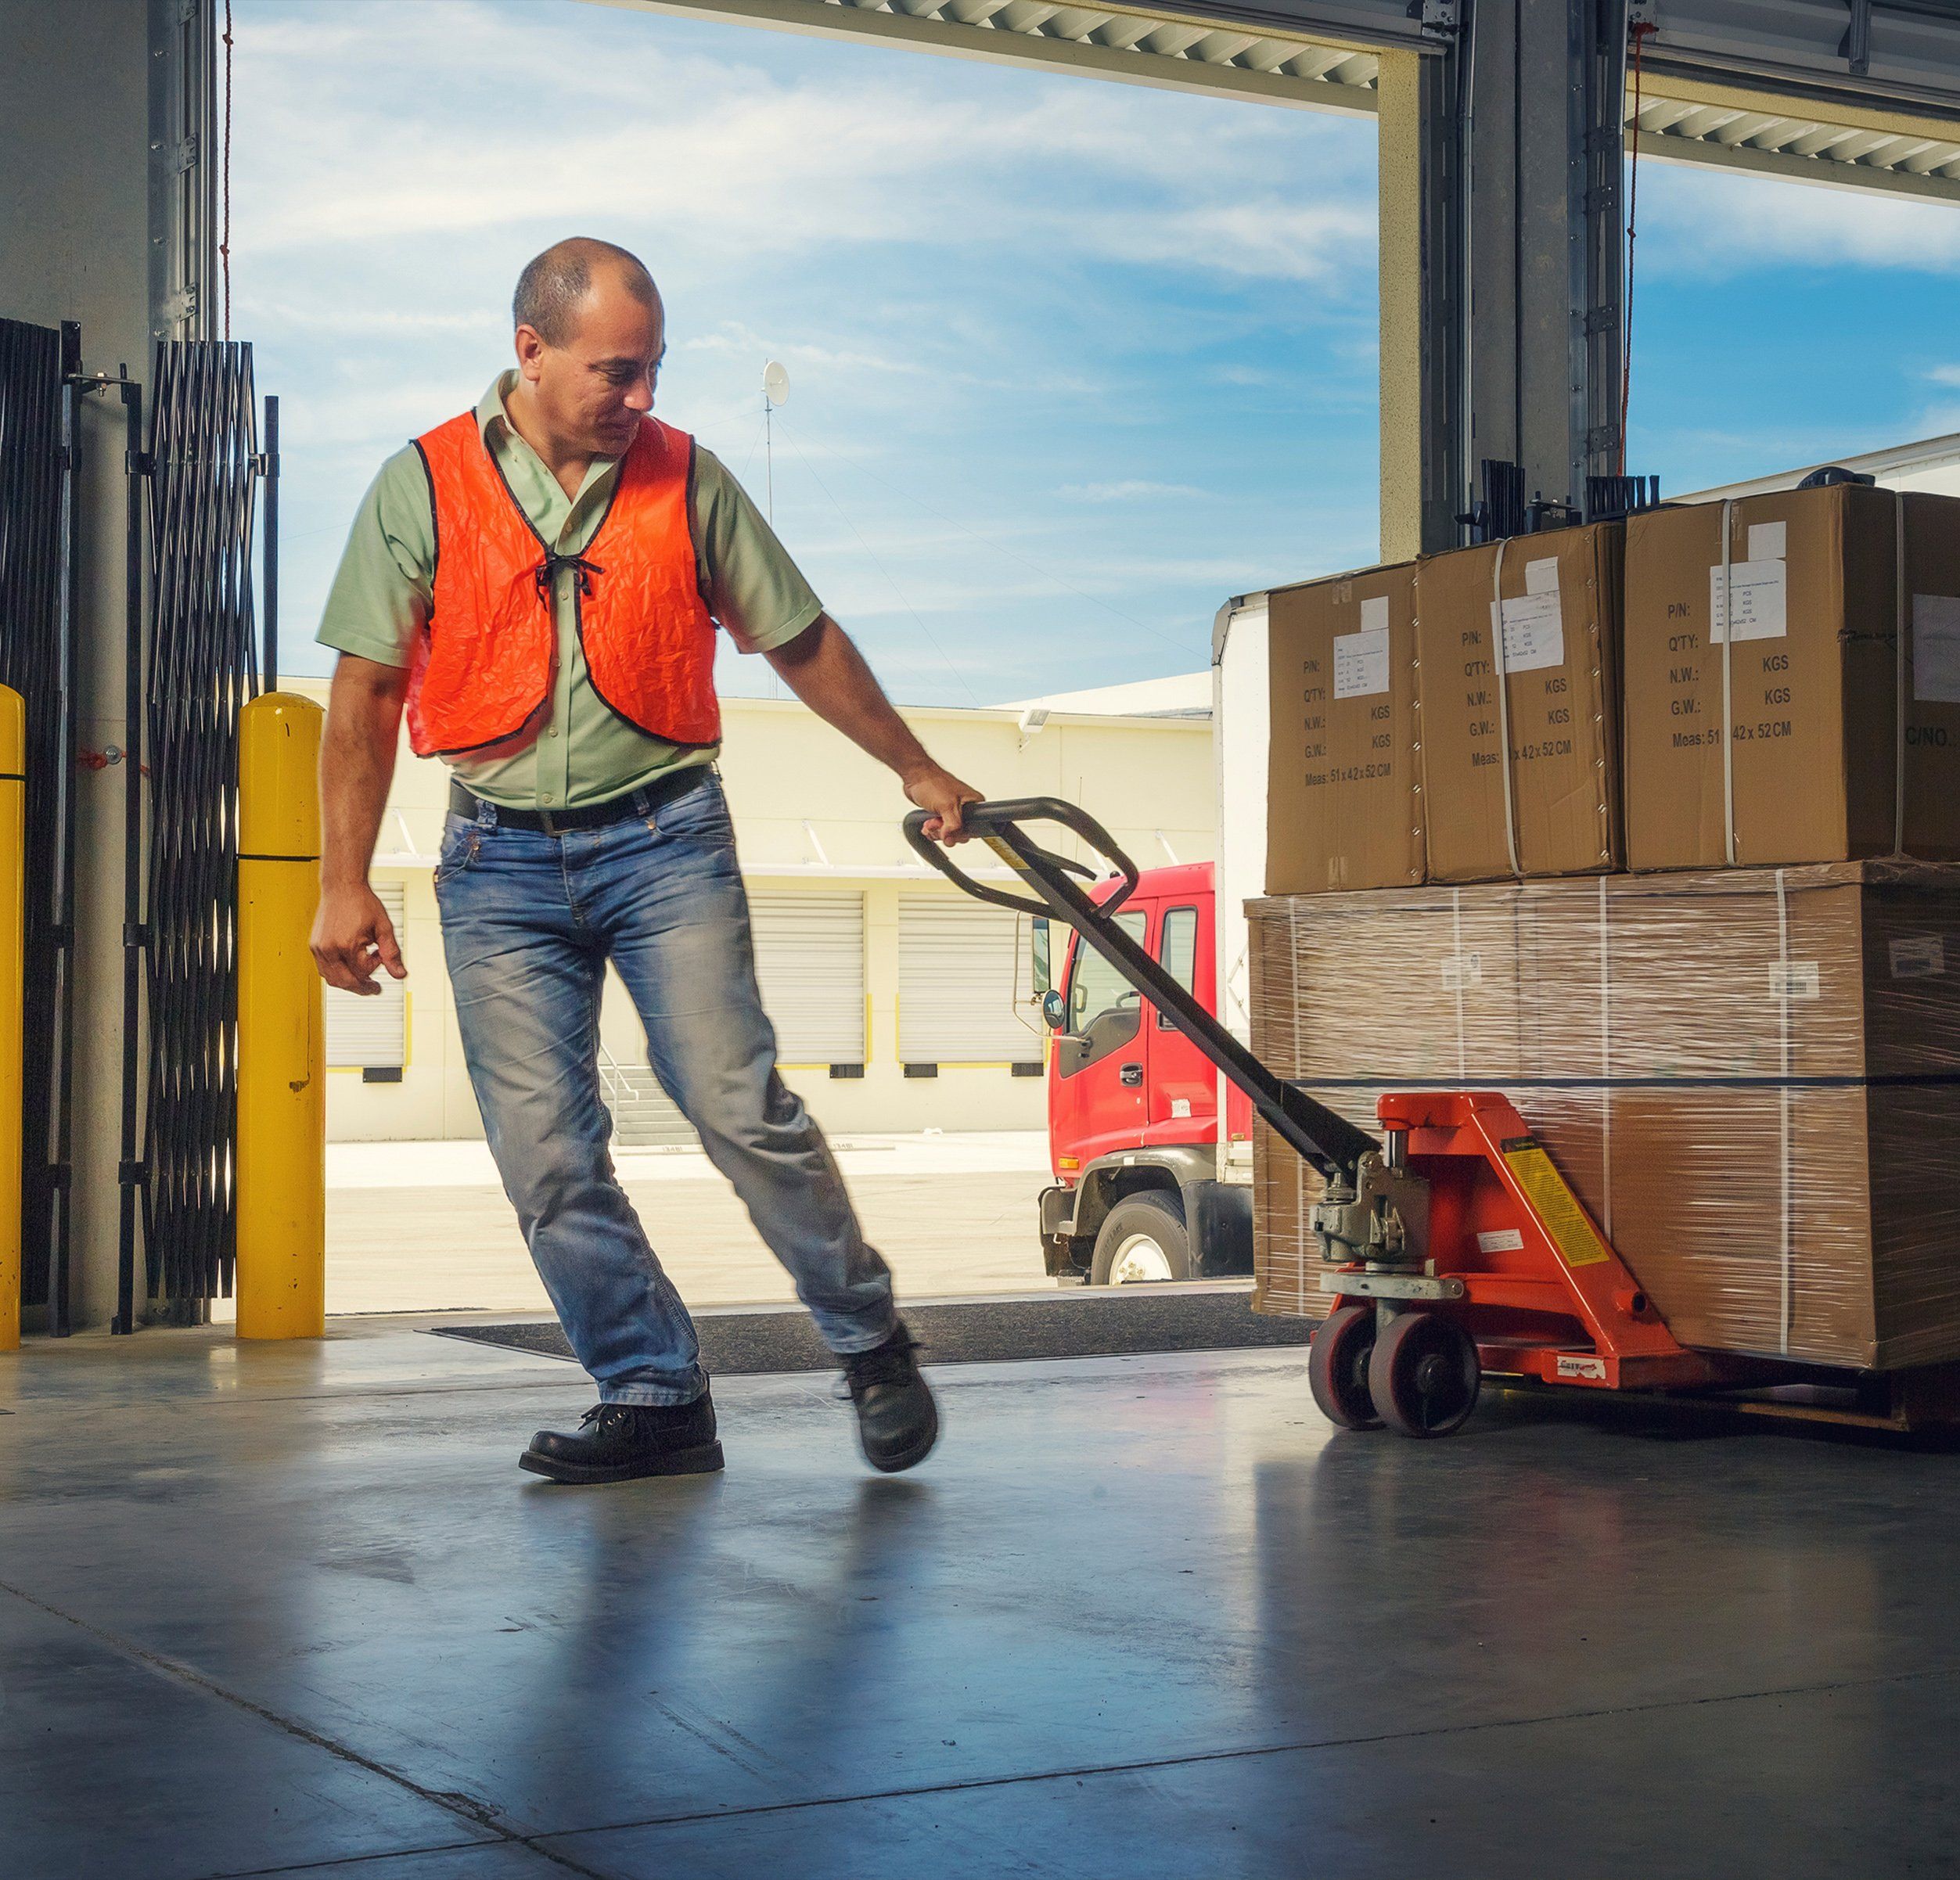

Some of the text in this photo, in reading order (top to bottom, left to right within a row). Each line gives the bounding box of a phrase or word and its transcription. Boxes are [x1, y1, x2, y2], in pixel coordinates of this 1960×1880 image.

[1667, 602, 1691, 619] P/N:
[1461, 630, 1483, 646] P/N:
[1668, 634, 1699, 652] Q'TY:
[1303, 660, 1321, 674] P/N:
[1464, 660, 1491, 677] Q'TY:
[1670, 654, 1789, 684] N.W.: KGS
[1304, 687, 1326, 703] Q'TY:
[1466, 678, 1567, 707] N.W.: KGS
[1670, 687, 1791, 715] G.W.: KGS
[1304, 705, 1390, 731] N.W.: KGS
[1469, 708, 1570, 737] G.W.: KGS
[1672, 732, 1706, 748] Meas:
[1772, 720, 1792, 738] CM
[1304, 733, 1391, 758] G.W.: KGS
[1471, 751, 1501, 767] Meas:
[1305, 773, 1329, 786] Meas:
